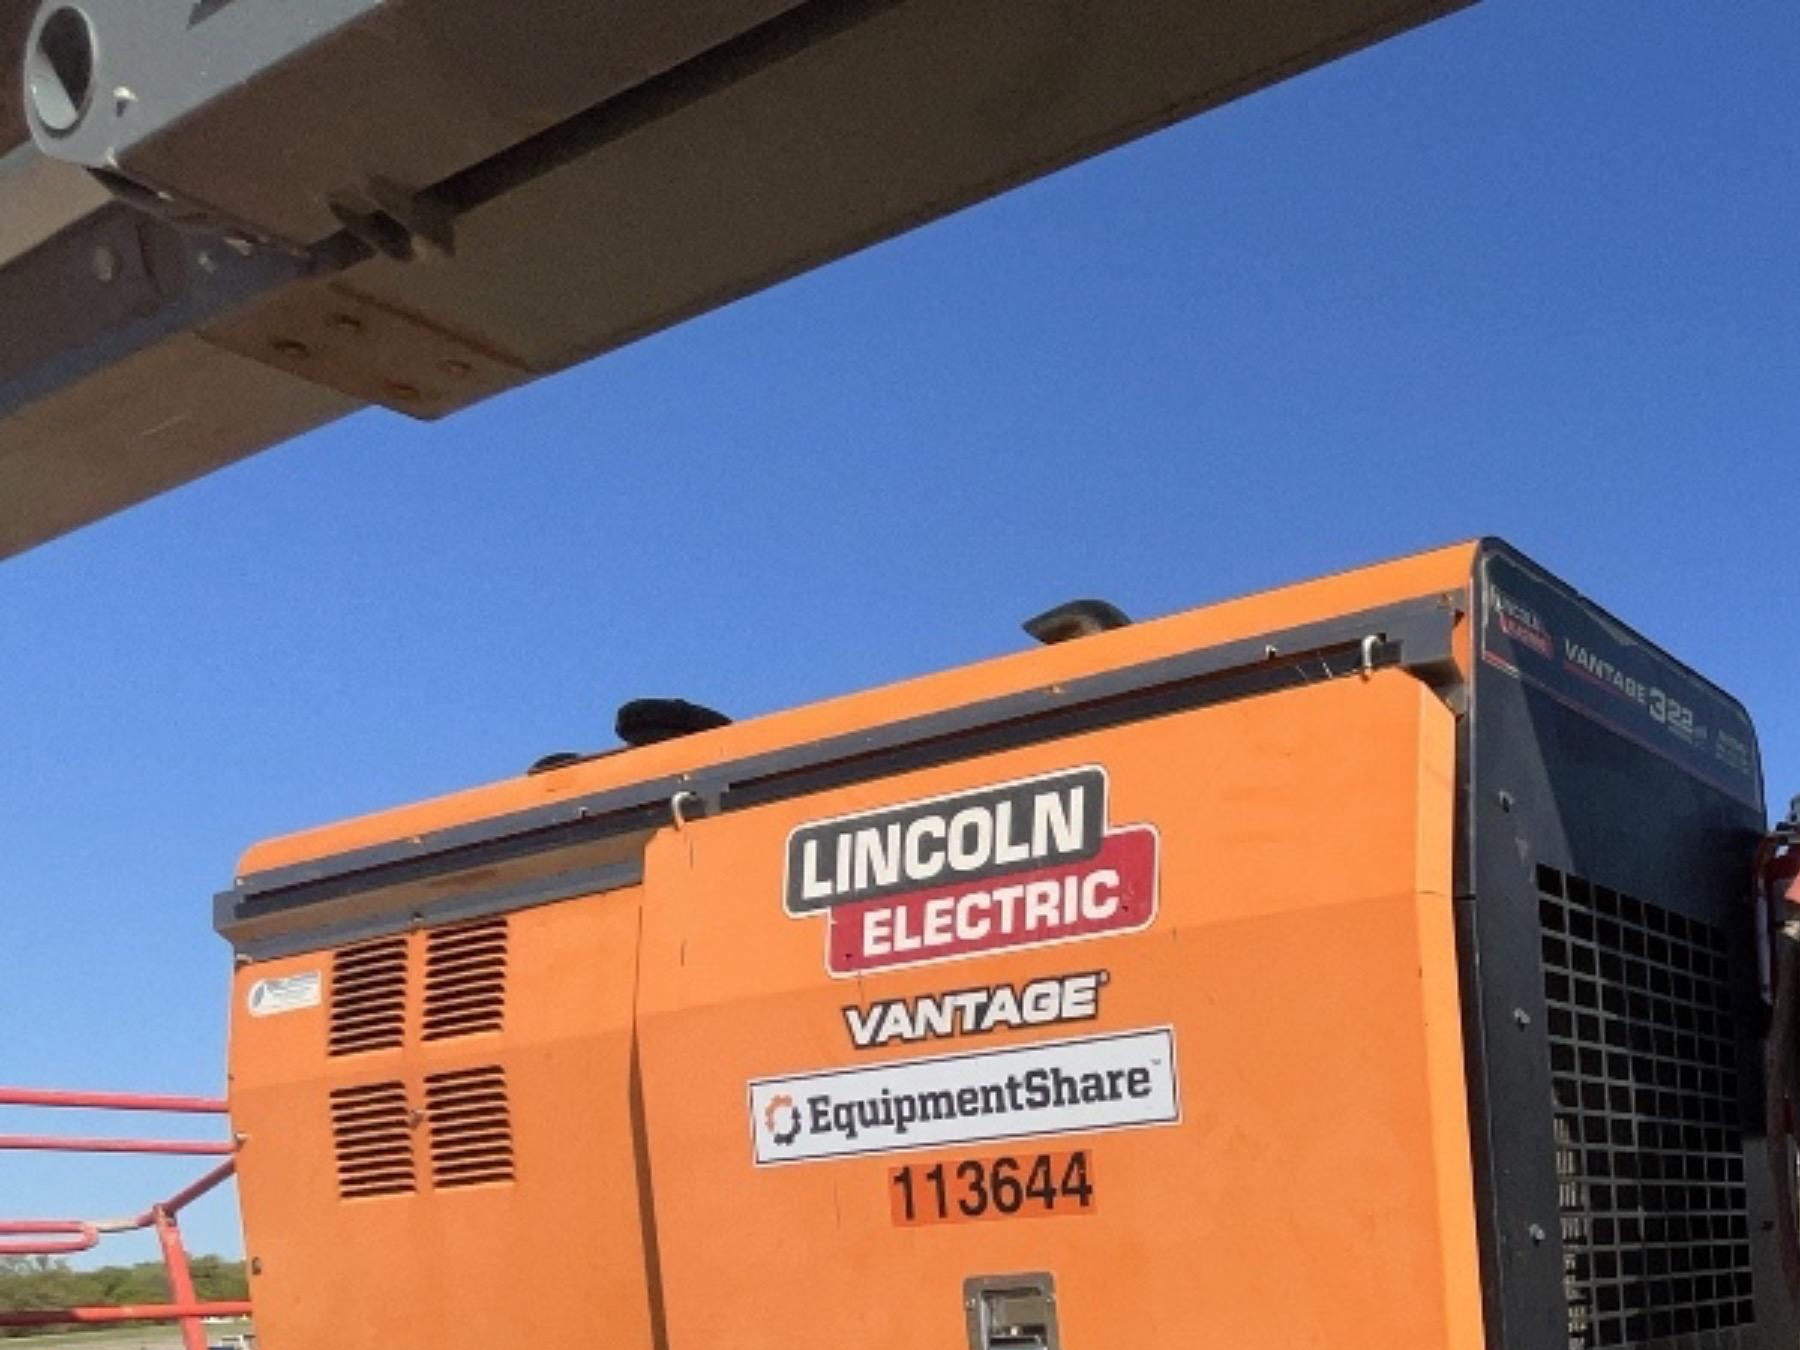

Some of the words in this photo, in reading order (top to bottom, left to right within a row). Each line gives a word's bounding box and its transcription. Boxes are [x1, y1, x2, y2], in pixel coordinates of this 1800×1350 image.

[1564, 637, 1647, 706] VANTAGE
[802, 786, 1084, 900] LINCOLN
[862, 869, 1119, 957] ELECTRIC
[843, 975, 1103, 1047] VANTAGE
[807, 1064, 1152, 1140] EquipmentShare
[894, 1152, 1092, 1219] 113644
